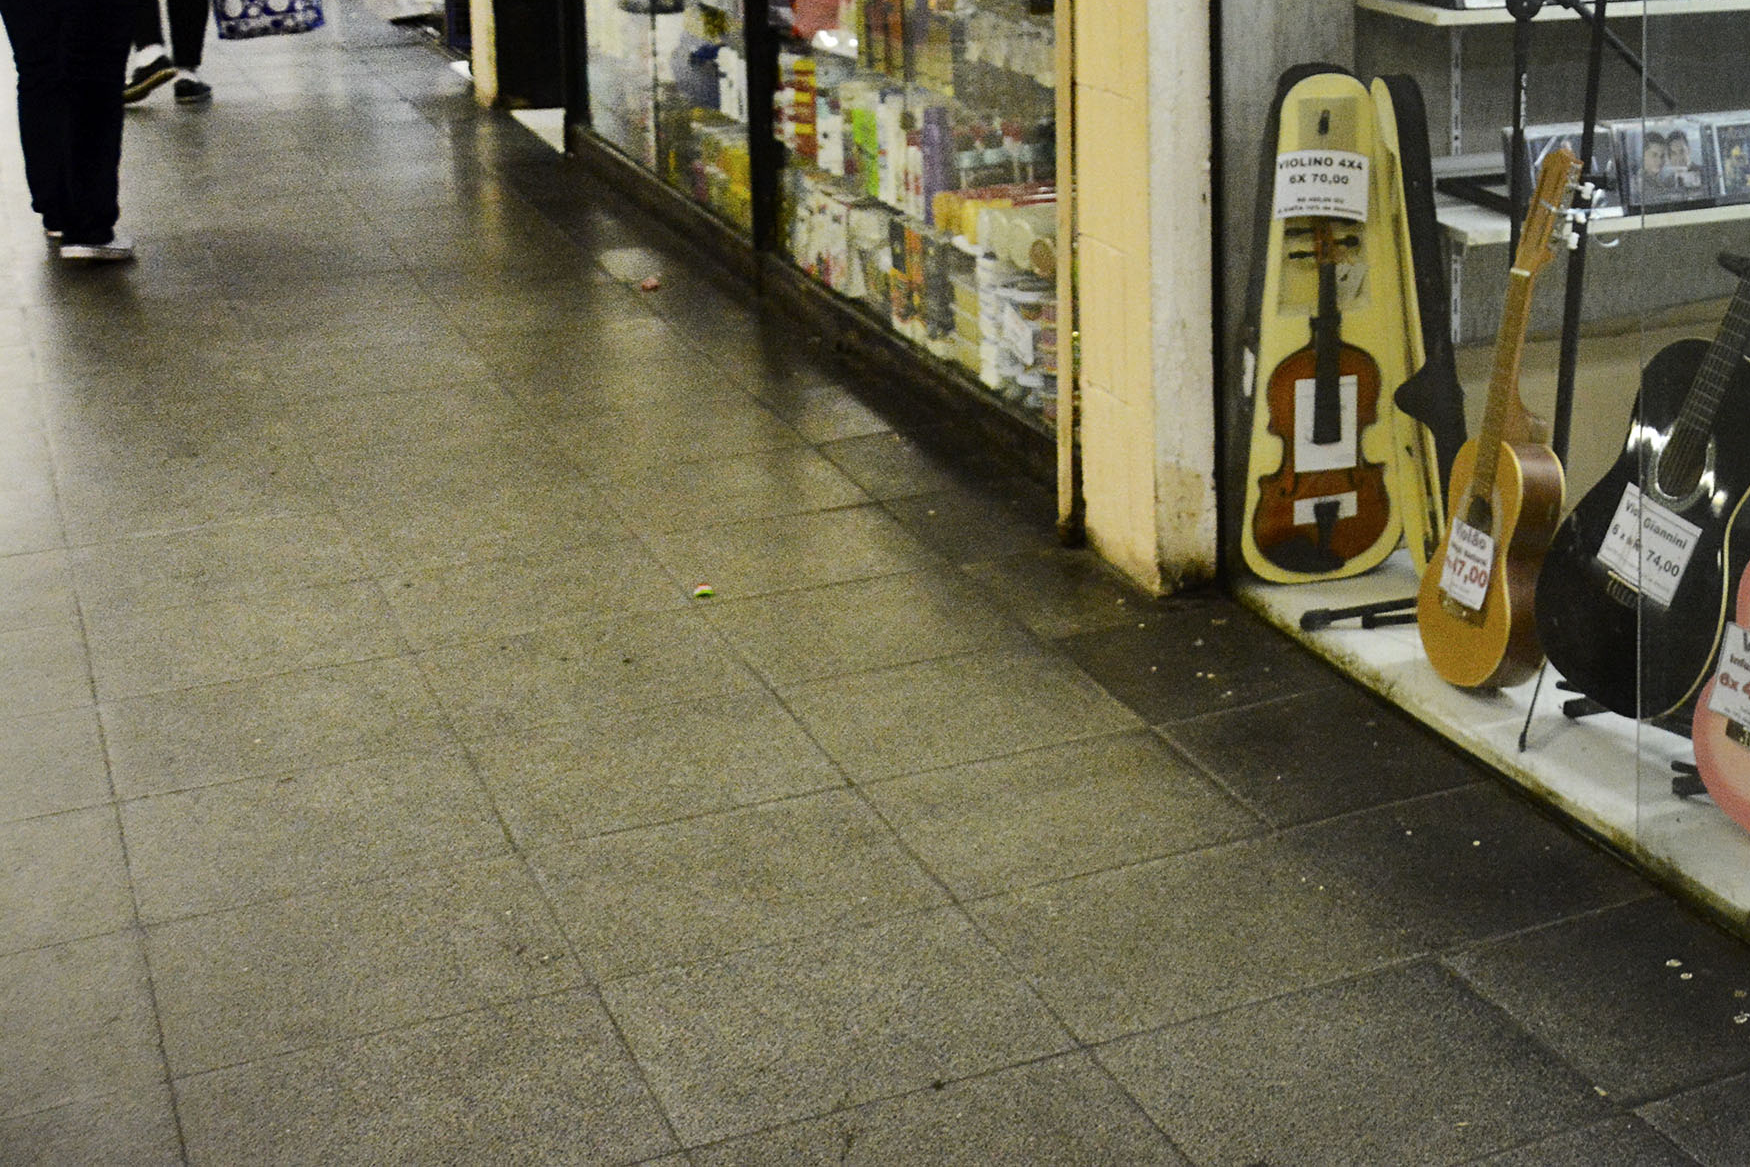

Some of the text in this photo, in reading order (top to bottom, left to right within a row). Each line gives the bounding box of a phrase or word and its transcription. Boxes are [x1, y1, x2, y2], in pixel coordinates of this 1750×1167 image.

[1312, 173, 1349, 185] 70,00
[1643, 517, 1689, 550] Giannini
[1646, 549, 1680, 577] 74,00
